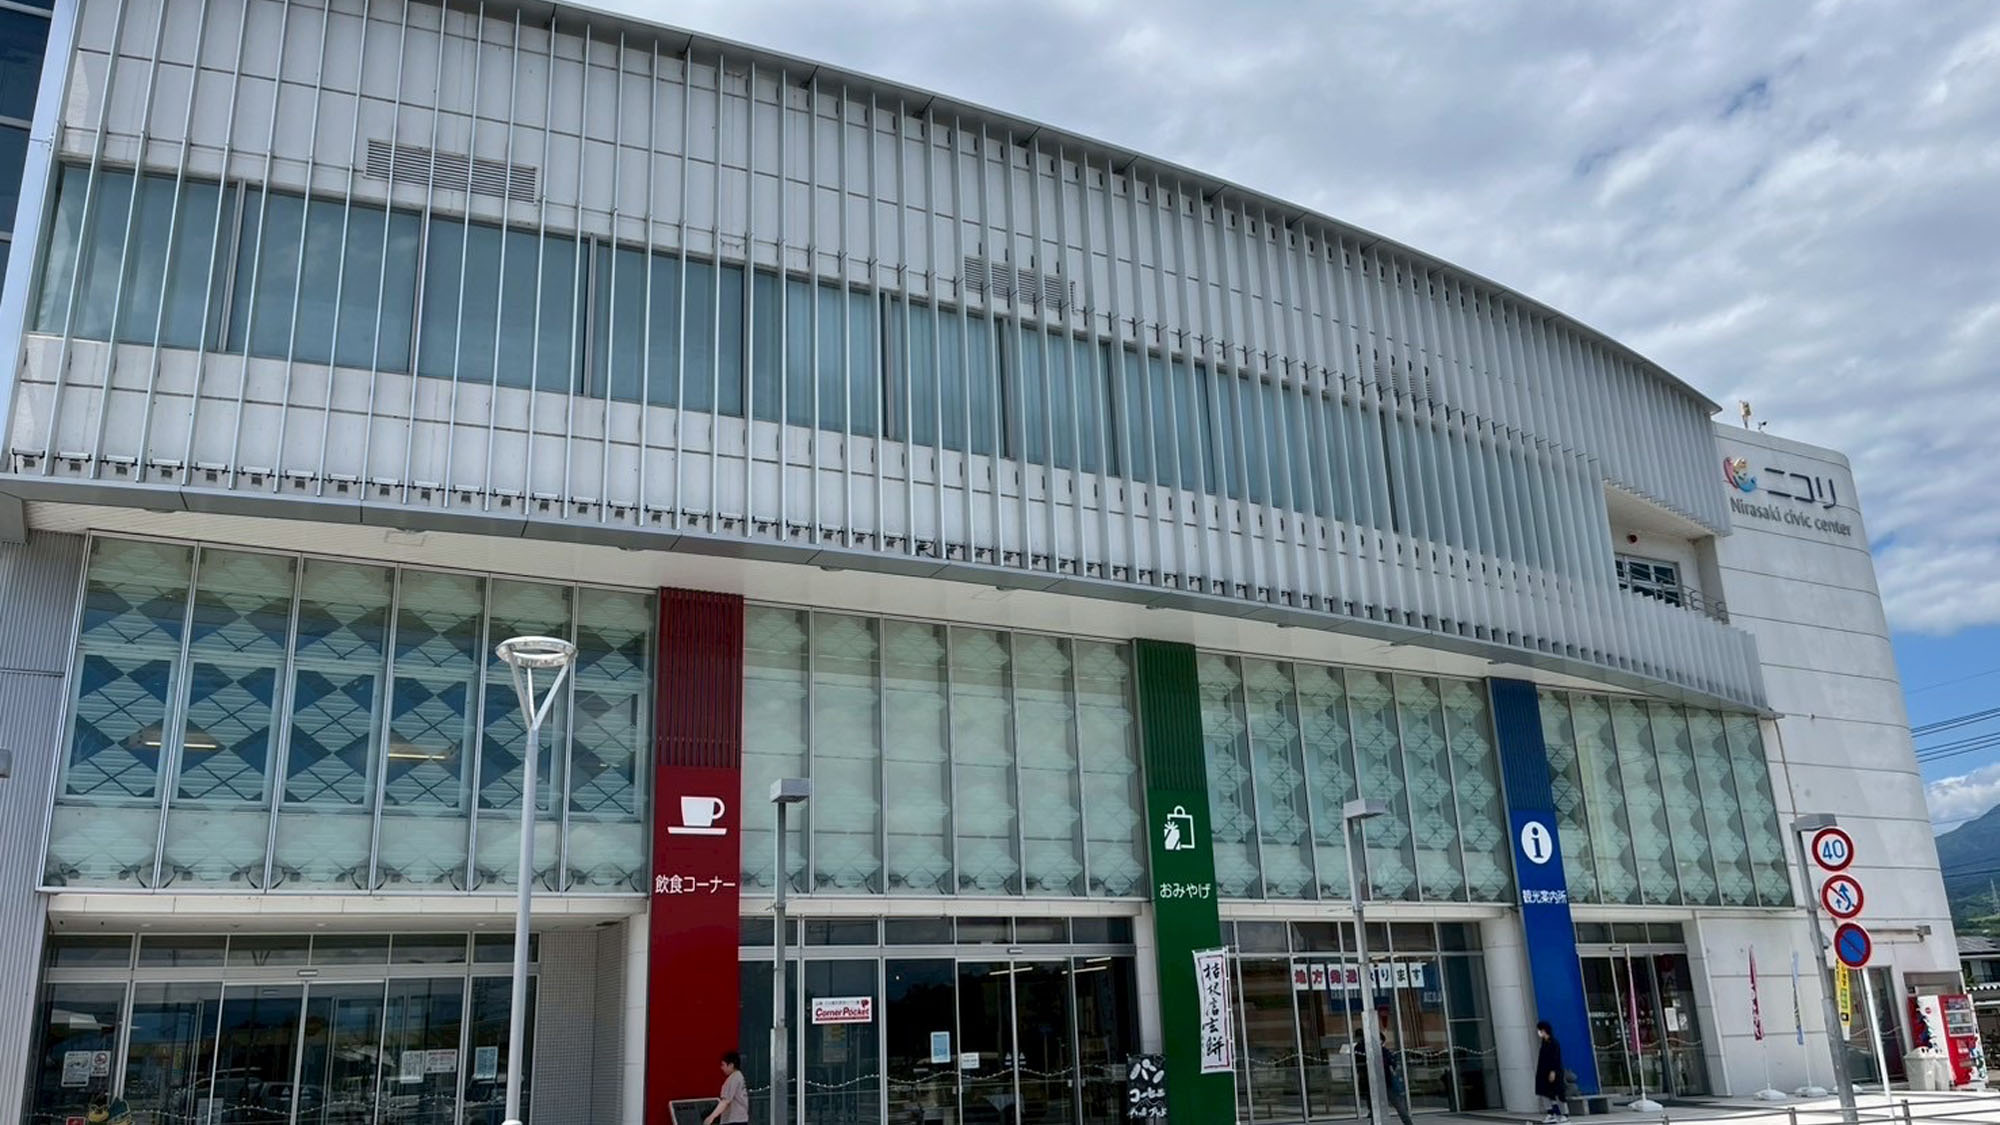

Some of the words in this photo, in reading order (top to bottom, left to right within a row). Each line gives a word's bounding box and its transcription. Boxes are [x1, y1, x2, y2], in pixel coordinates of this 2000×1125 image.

[1764, 467, 1837, 510] ニコリ
[1729, 497, 1782, 523] Nirasaki
[1784, 508, 1812, 528] civic
[1814, 517, 1852, 537] center
[1822, 839, 1846, 860] 40
[655, 874, 736, 894] 飲食コーナー
[1159, 882, 1211, 899] おみやげ
[1522, 889, 1568, 904] 観光案内所
